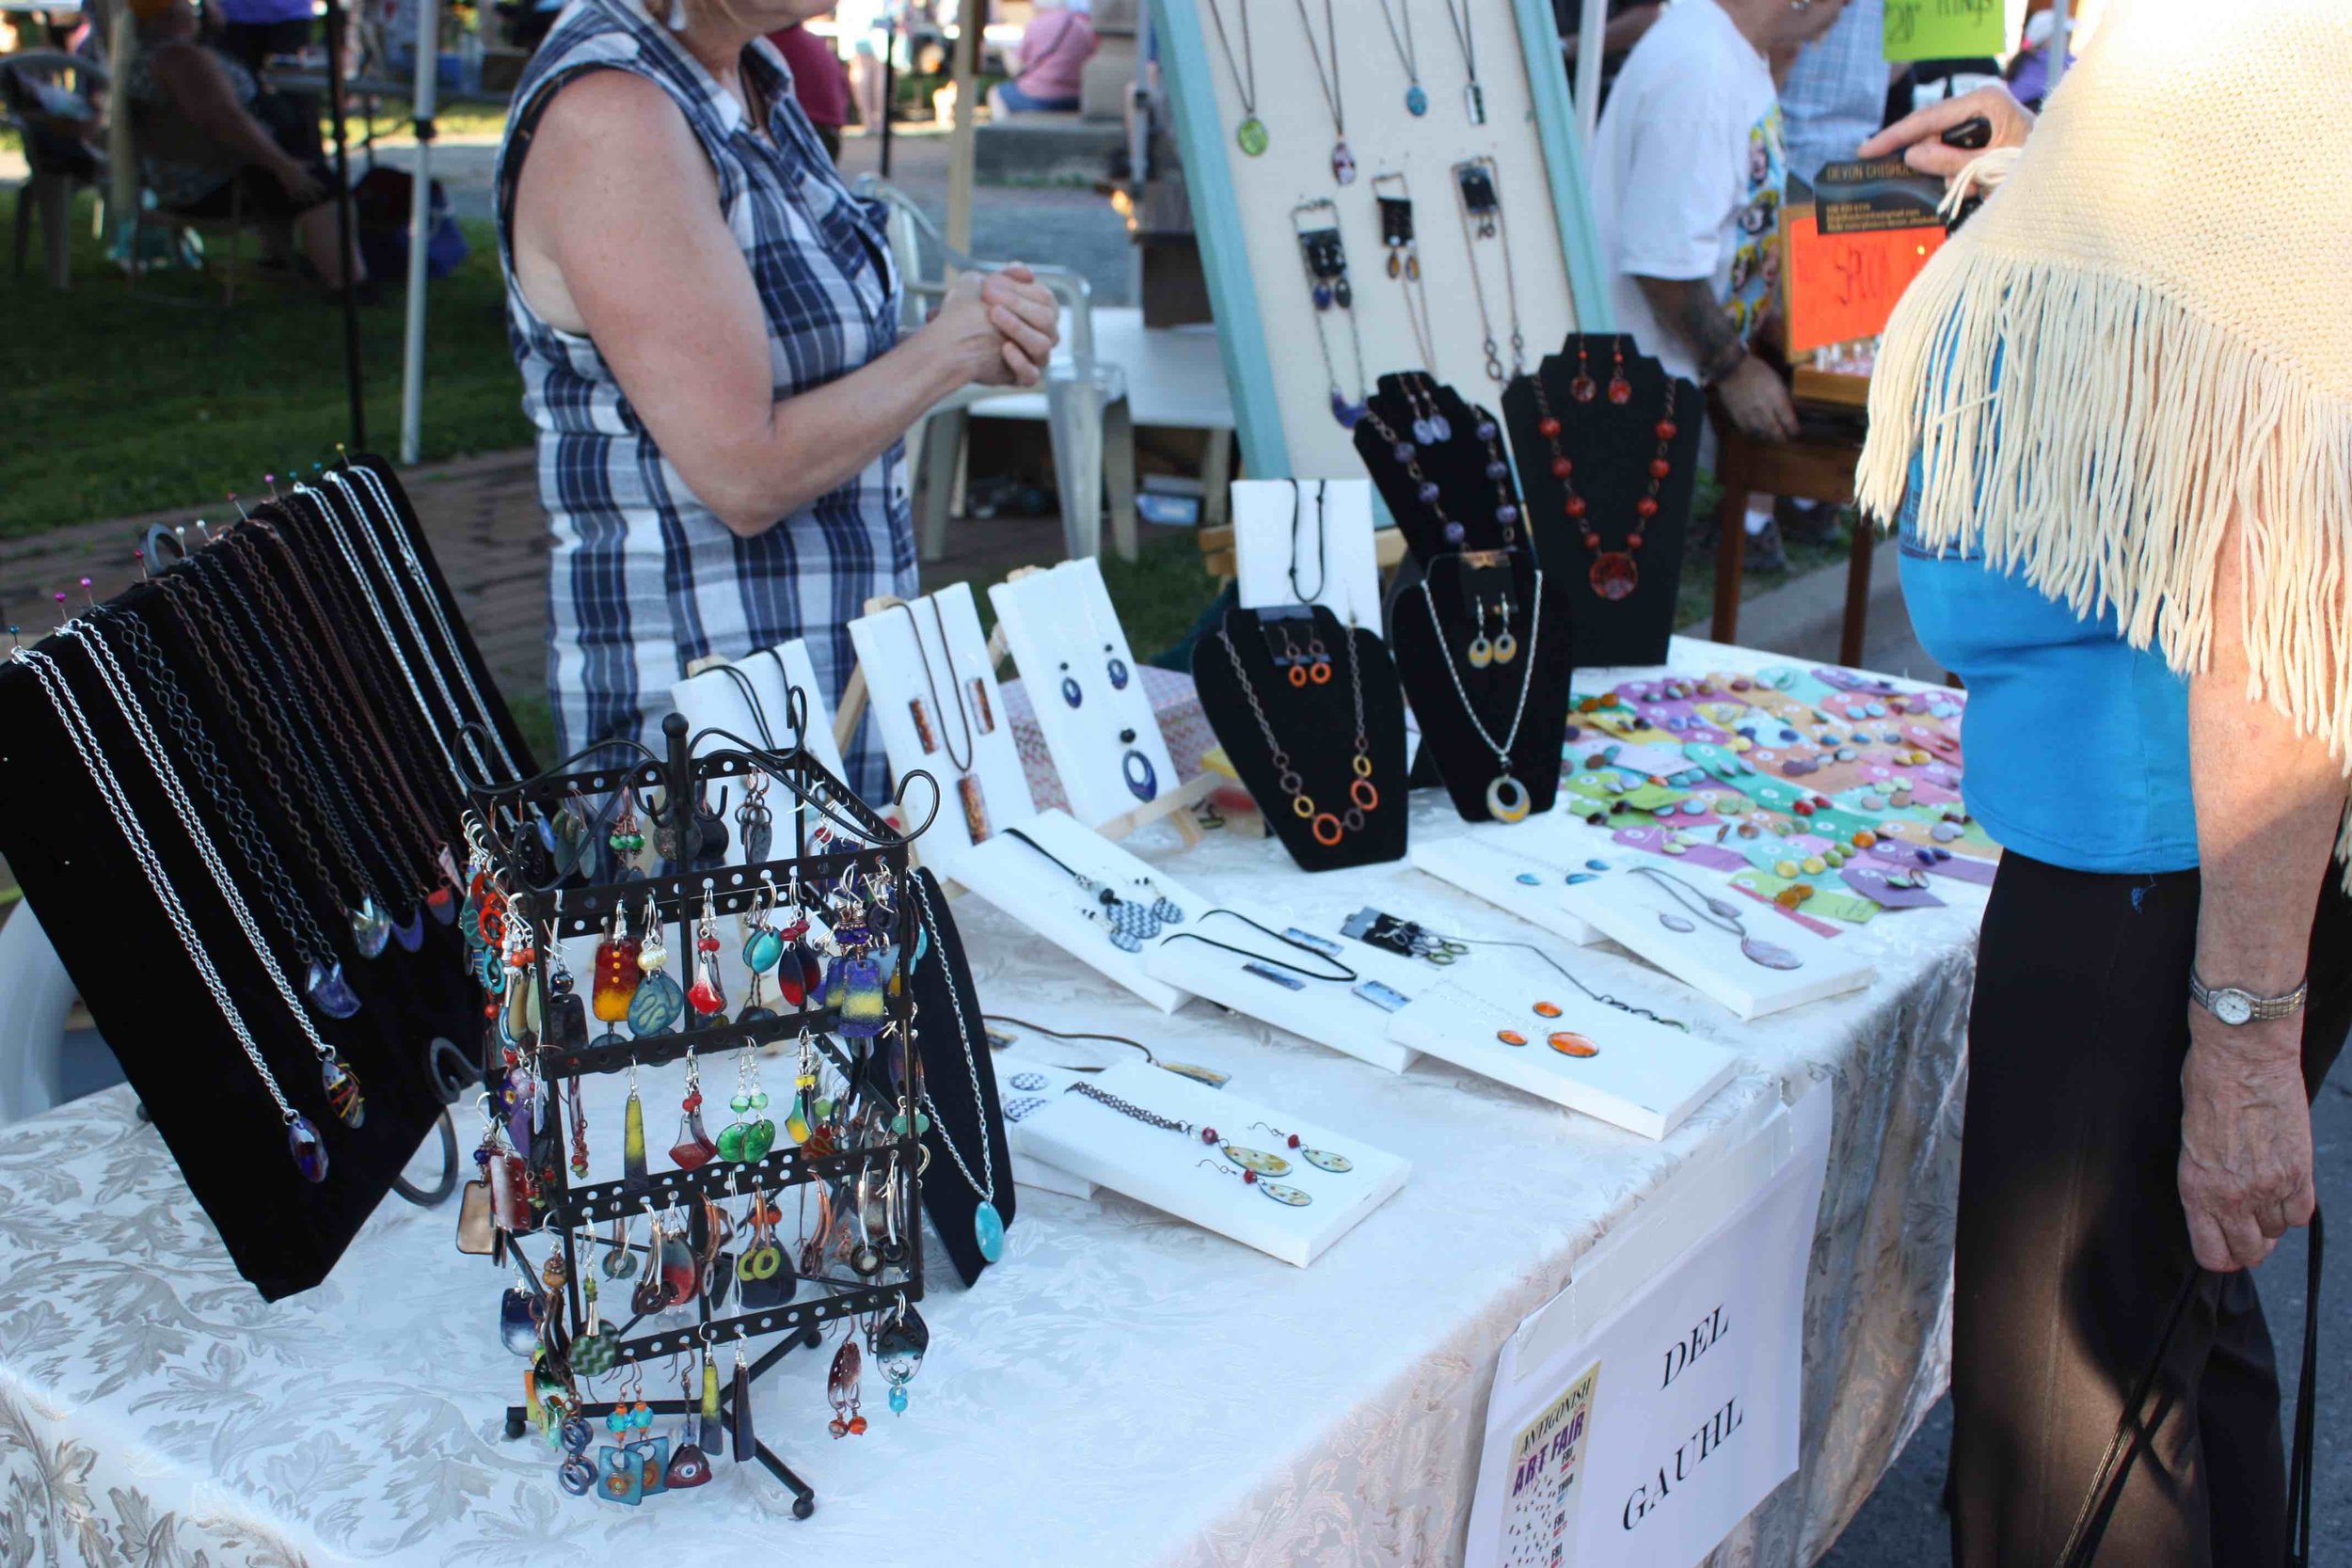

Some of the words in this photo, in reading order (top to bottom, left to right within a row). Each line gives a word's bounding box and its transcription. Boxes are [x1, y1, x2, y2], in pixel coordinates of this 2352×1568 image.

[1661, 1304, 1729, 1391] DEL
[1512, 1443, 1549, 1497] ART
[1550, 1411, 1585, 1462] FAIR
[1519, 1376, 1592, 1456] ANTIGONISH
[1623, 1396, 1743, 1531] GAUHL
